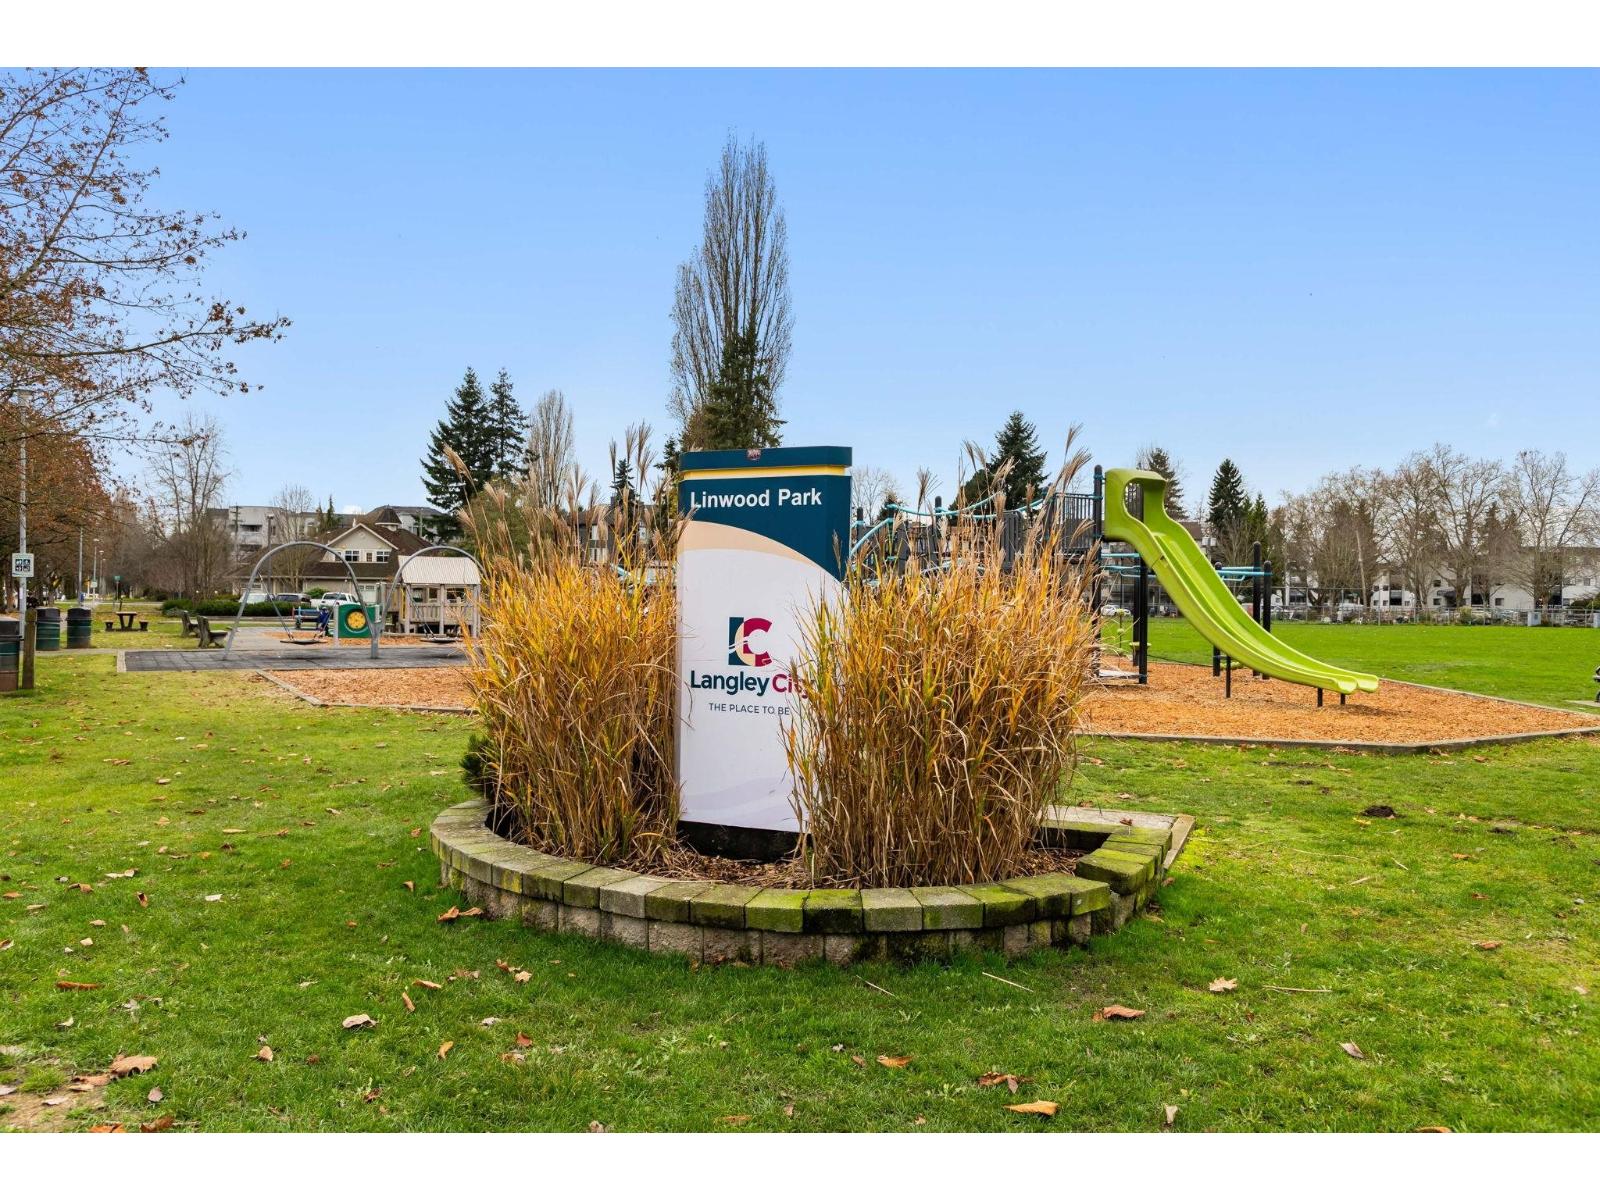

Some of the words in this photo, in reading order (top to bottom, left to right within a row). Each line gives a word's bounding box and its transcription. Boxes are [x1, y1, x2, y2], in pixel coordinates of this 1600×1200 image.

[691, 489, 770, 508] Linwood
[778, 487, 822, 506] Park
[691, 670, 770, 696] Langley
[708, 702, 727, 712] THE
[729, 703, 759, 714] PLACE
[761, 705, 775, 715] TO
[777, 706, 790, 716] BE
